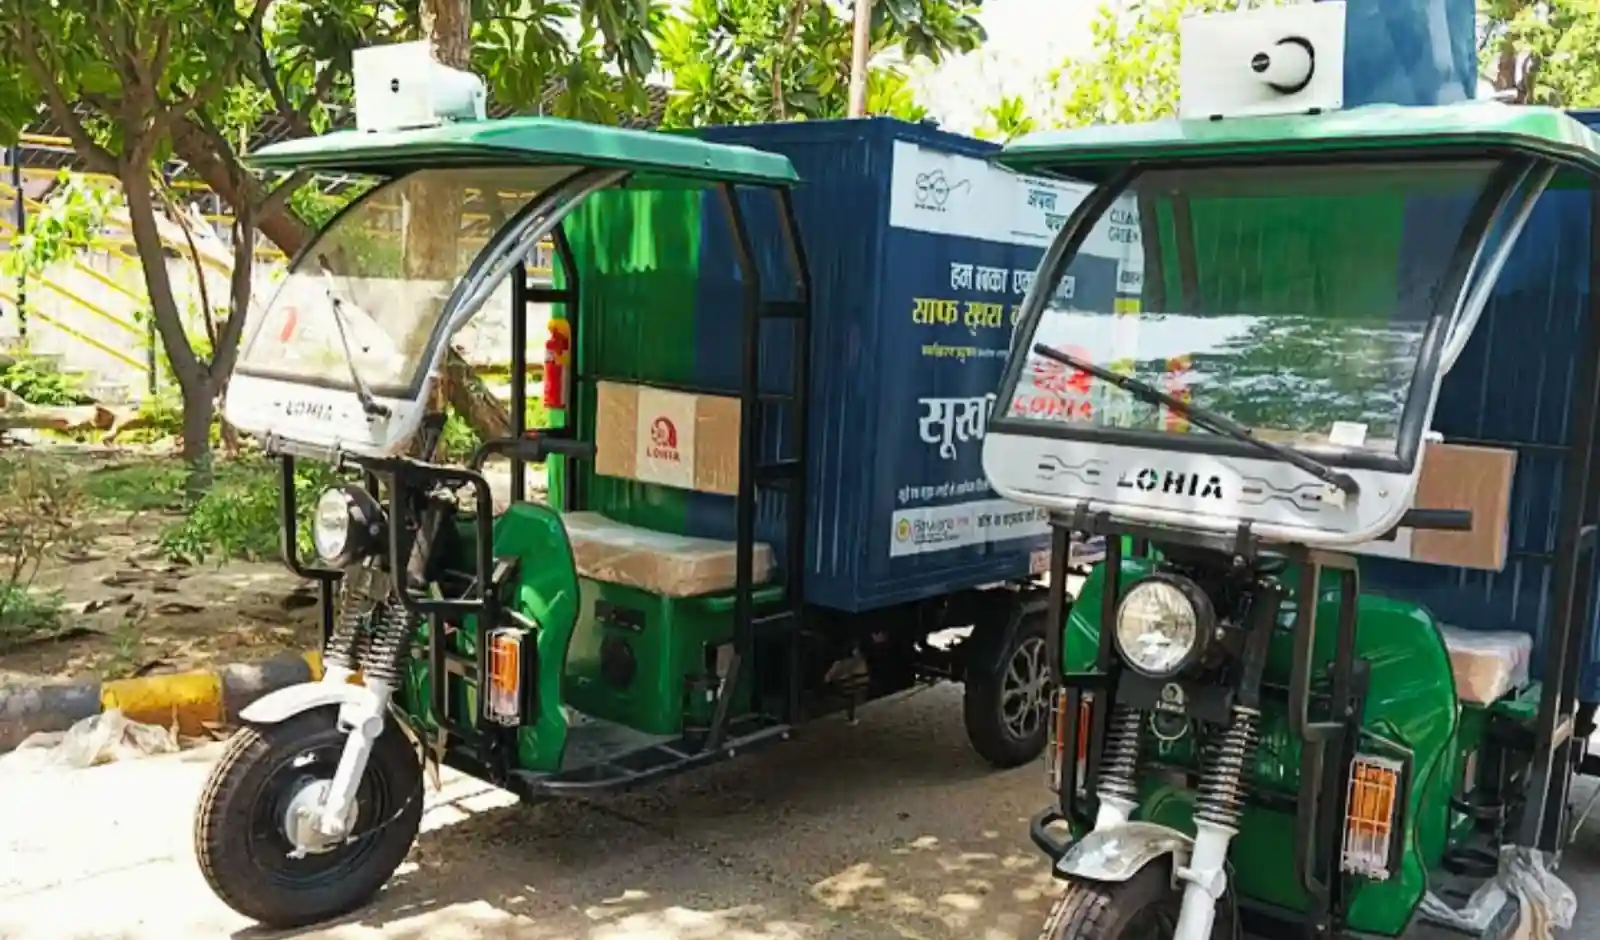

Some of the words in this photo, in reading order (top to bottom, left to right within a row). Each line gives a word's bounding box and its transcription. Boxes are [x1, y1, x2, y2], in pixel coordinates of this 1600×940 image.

[912, 296, 960, 327] साफ
[646, 445, 681, 463] LOHIA
[1116, 467, 1224, 499] LOHIA
